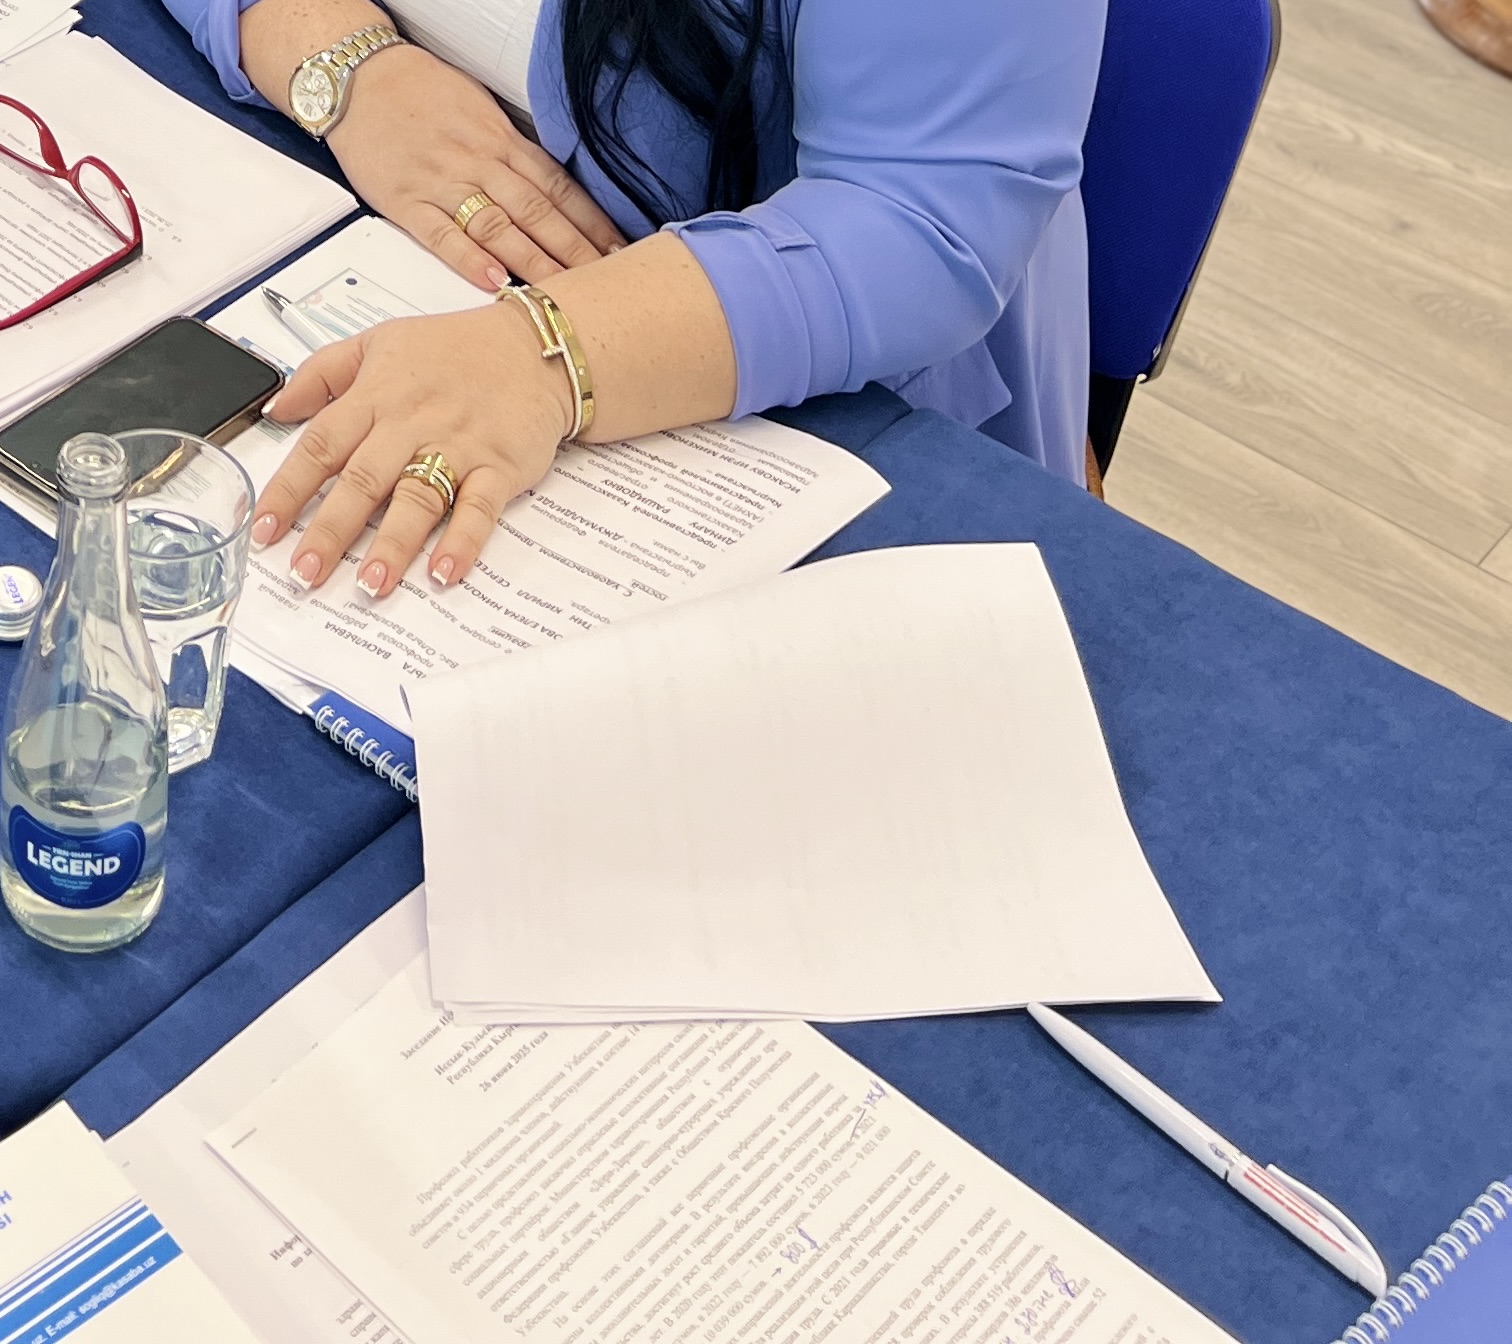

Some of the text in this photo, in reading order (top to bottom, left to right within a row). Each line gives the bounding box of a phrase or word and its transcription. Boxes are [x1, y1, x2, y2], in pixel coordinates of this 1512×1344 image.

[718, 452, 749, 470] ИРЭН
[749, 465, 801, 494] ИСАКОВУ
[552, 465, 718, 550] представителей Казахстанского
[586, 456, 745, 539] Казахстанского отраслевого
[680, 466, 766, 510] представителей
[712, 470, 783, 508] Кыргызстана
[601, 475, 737, 547] ДИНАРУ РАШИДОВНУ
[528, 502, 671, 578] председателя Федерации
[537, 544, 620, 591] удовольствием
[628, 540, 697, 580] Кыргызстана
[425, 598, 460, 624] здесь
[502, 606, 539, 630] ЕЛЕНА
[516, 587, 563, 615] КИРИЛЛ
[308, 594, 436, 669] профсоюза работников
[324, 619, 392, 661] ВАСИЛЬЕВНА
[402, 630, 438, 657] Ольга
[457, 621, 502, 650] сегодня
[26, 840, 121, 877] LEGEND
